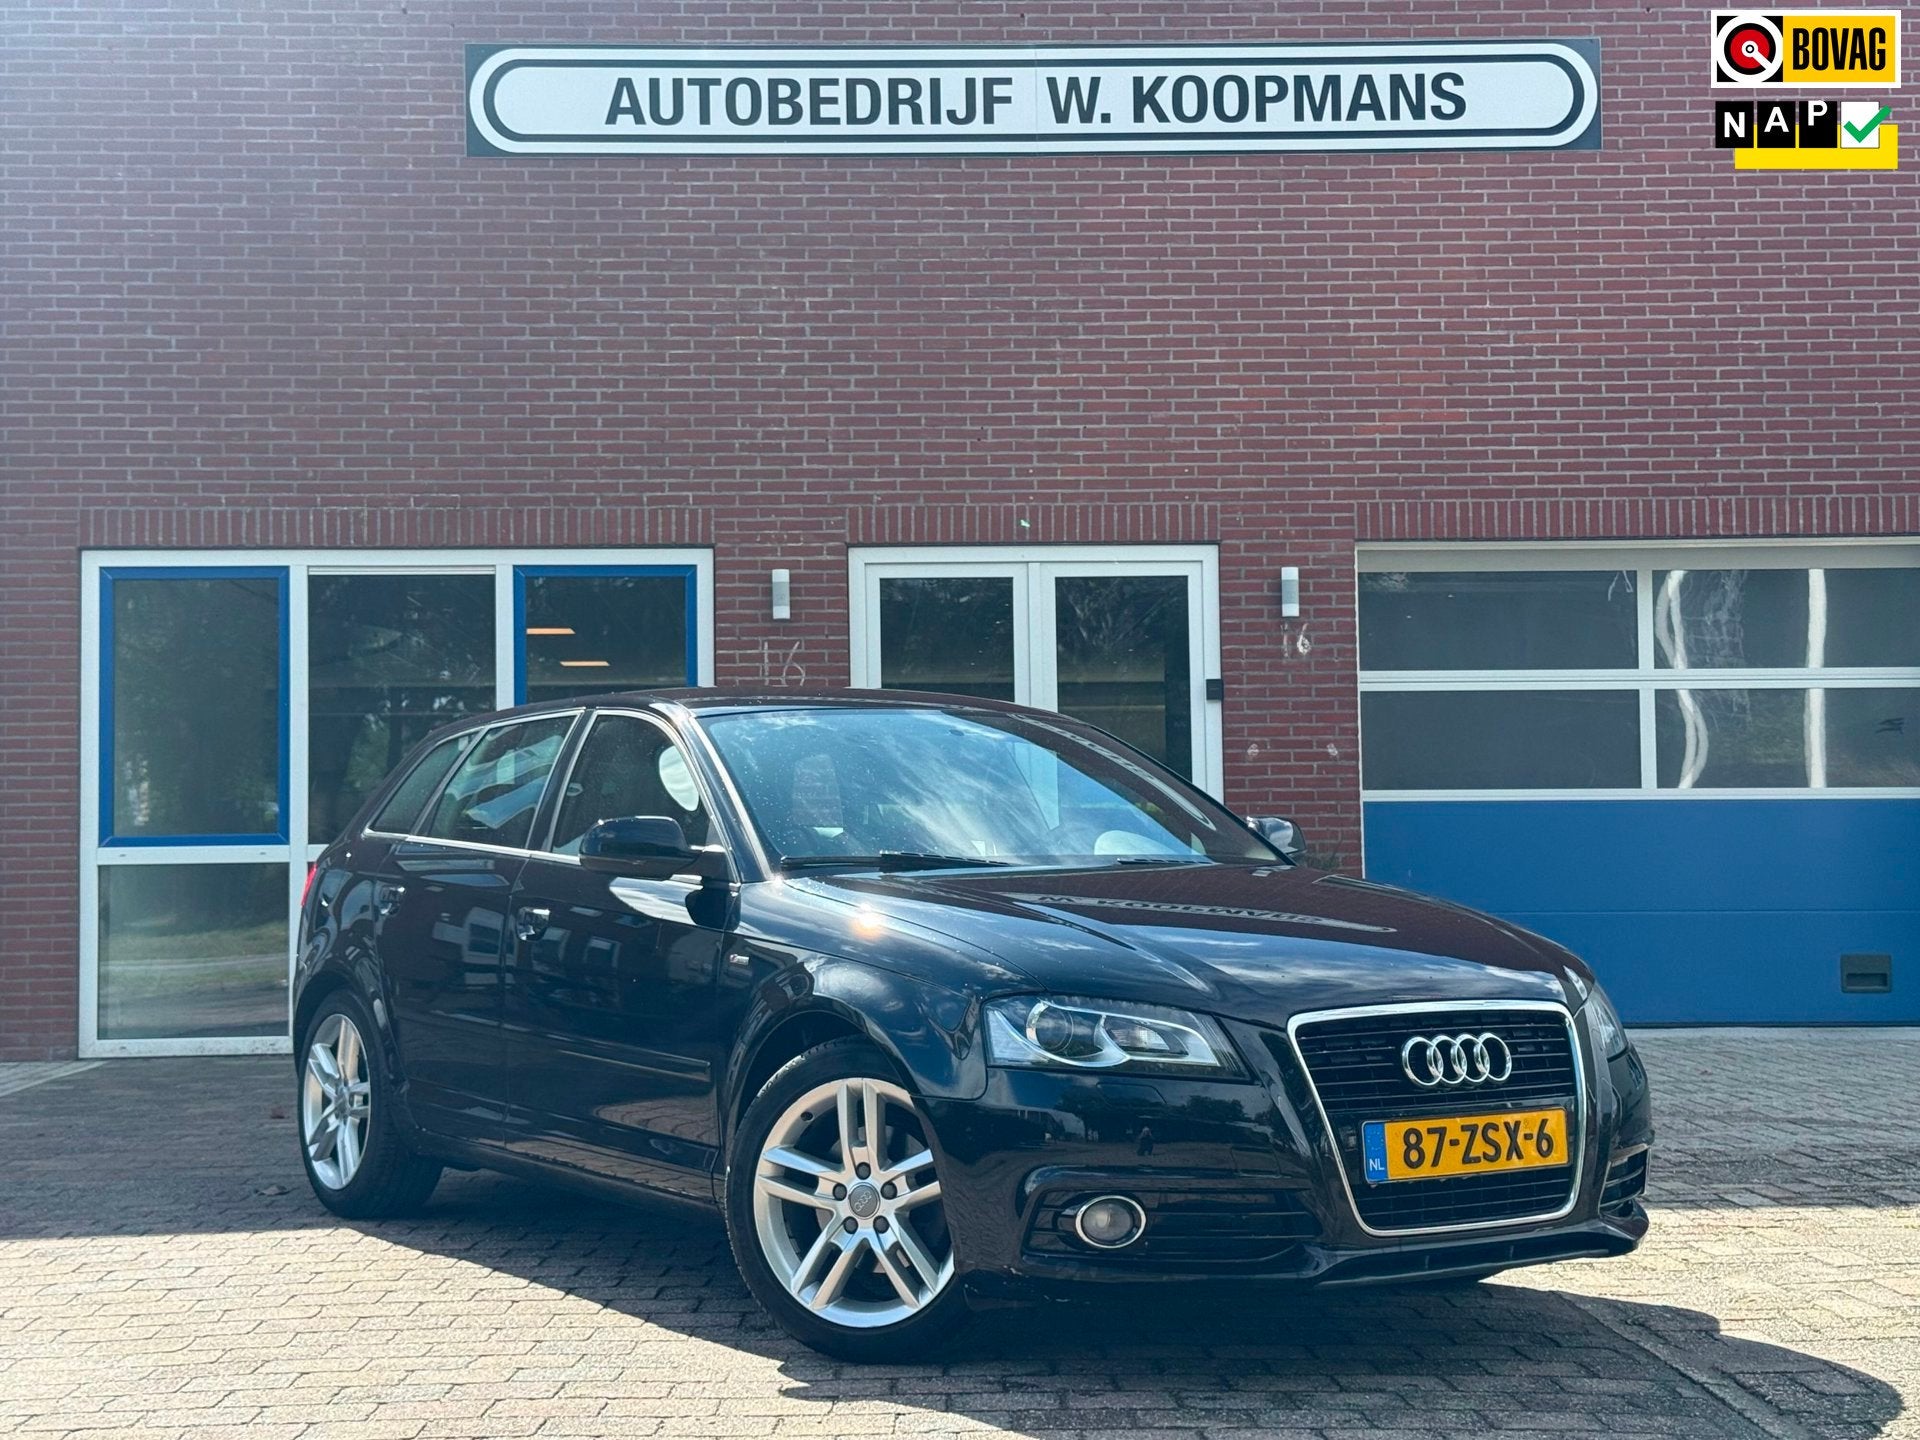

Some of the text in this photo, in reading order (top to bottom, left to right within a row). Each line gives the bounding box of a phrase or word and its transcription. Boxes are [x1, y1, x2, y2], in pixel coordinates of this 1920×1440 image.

[604, 72, 1467, 126] AUTOBEDRIJF W. KOOPMANS
[1369, 1158, 1385, 1171] NL
[1402, 1118, 1554, 1170] 87-ZSX-6
